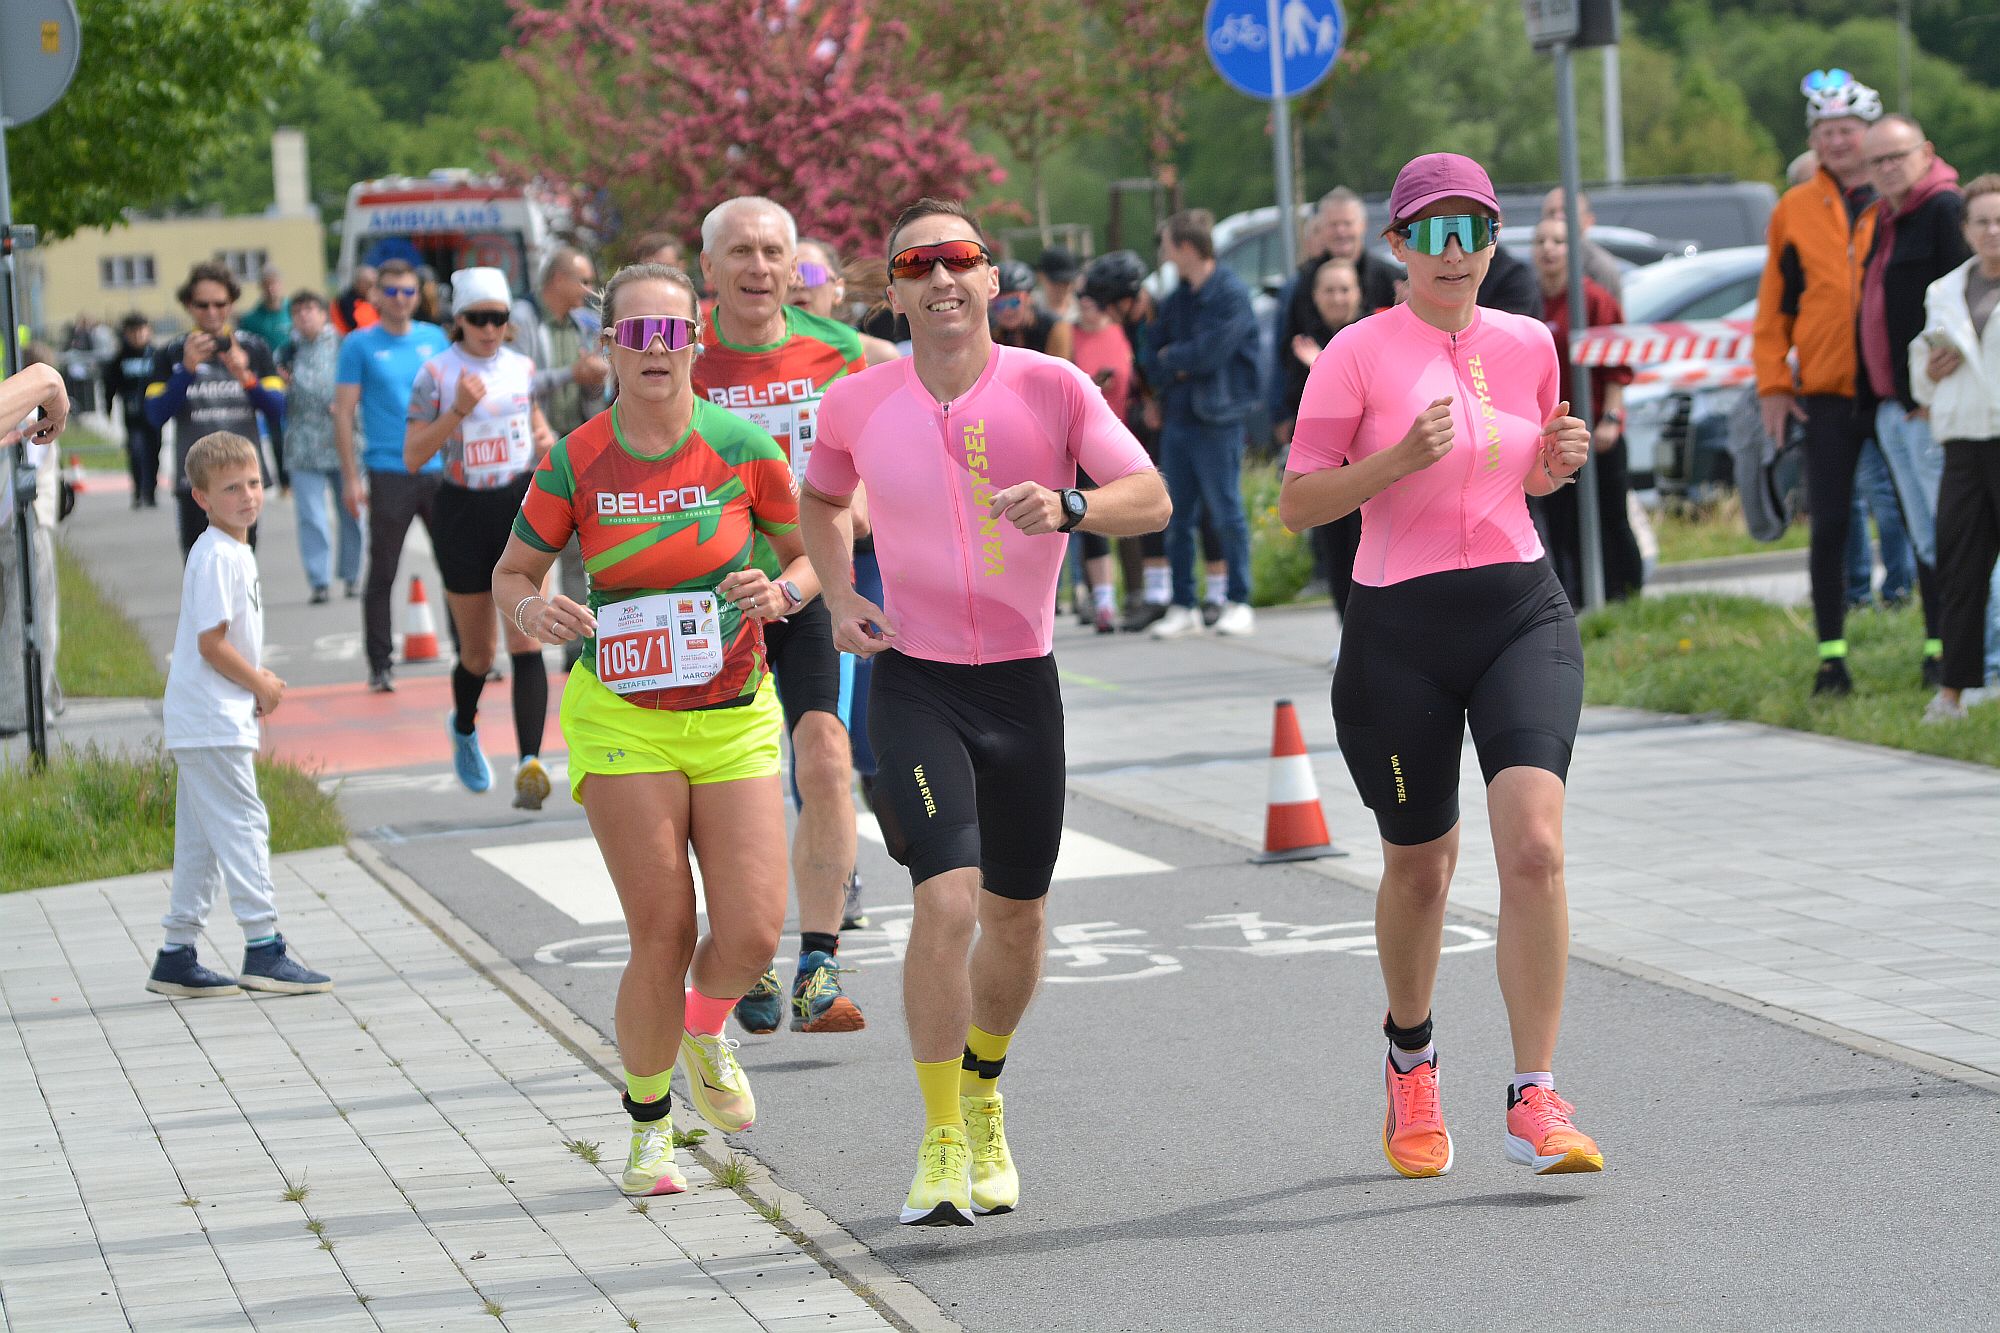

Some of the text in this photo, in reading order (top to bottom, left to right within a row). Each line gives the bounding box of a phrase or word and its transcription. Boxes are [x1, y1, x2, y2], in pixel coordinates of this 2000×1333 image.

[368, 207, 502, 230] AMBULANS
[1467, 354, 1502, 471] VAN RYSEL
[466, 439, 508, 467] 110/1
[596, 485, 720, 515] BEL-POL
[685, 509, 711, 518] PANELE
[963, 418, 1005, 577] VAN RYSEL
[601, 635, 667, 676] 105/1
[617, 679, 657, 690] SZTAFETA
[913, 764, 937, 818] VAN RYSEL
[1390, 754, 1406, 804] VAN RYSEL
